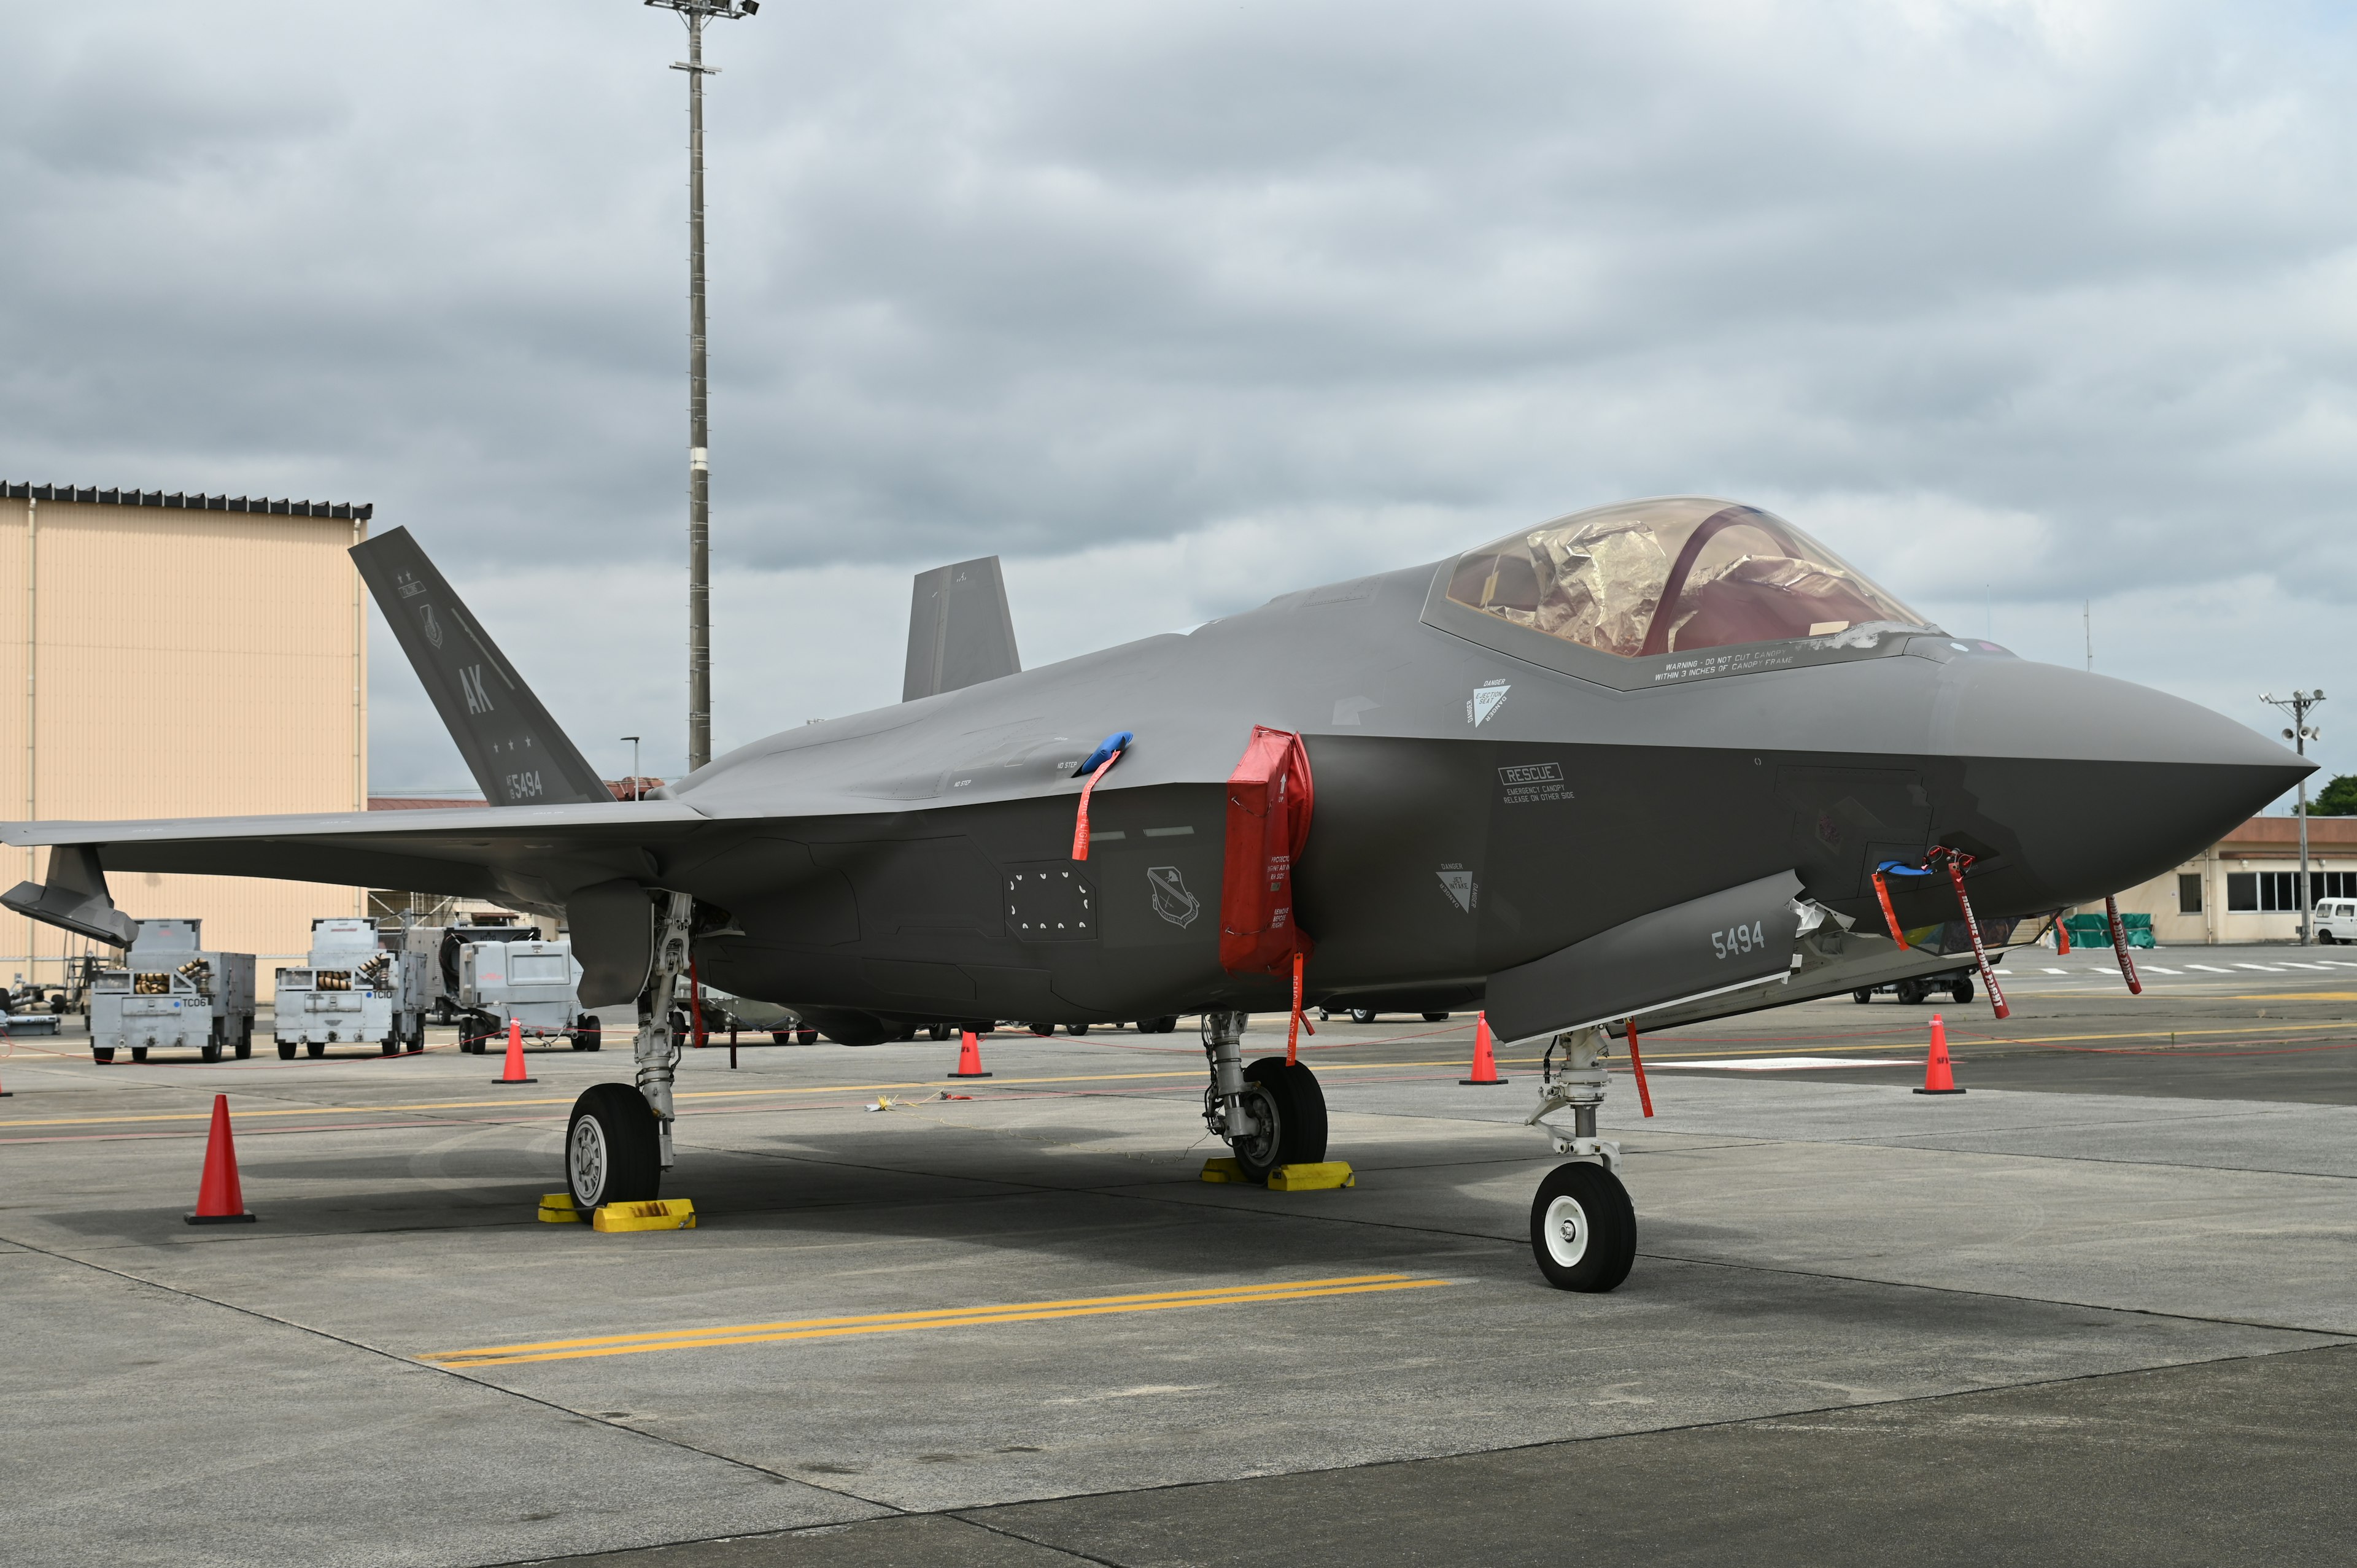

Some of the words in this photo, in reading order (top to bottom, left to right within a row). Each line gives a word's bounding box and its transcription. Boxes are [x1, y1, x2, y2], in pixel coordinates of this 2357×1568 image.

[1655, 671, 1679, 681] WITHIN
[1689, 666, 1716, 676] INCHES
[1732, 660, 1763, 670] CANOPY
[1765, 656, 1794, 666] FRAME
[1666, 660, 1698, 671] WARNING
[1717, 655, 1732, 664] NOT
[1735, 653, 1751, 662] CUT
[1754, 649, 1786, 659] CANOPY
[459, 664, 495, 715] AK
[1483, 678, 1506, 687] DANGER
[1485, 696, 1507, 722] DANGER
[511, 770, 543, 799] 5494
[1506, 765, 1555, 782] RESCUE
[1503, 795, 1530, 805] RELEASE
[1540, 792, 1560, 801] OTHER
[1561, 791, 1575, 800] SIDE
[1506, 786, 1540, 796] EMERGENCY
[1542, 784, 1565, 793] CANOPY
[1078, 819, 1089, 850] FLIGHT
[1439, 882, 1460, 908] DANGER
[1711, 921, 1765, 960] 5494
[1962, 895, 1979, 936] REMOVE
[1973, 937, 1991, 974] BEFORE
[1984, 975, 2004, 1007] FLIGHT
[2113, 922, 2127, 956] BEFORE
[182, 998, 206, 1007] TC06
[373, 990, 392, 999] TC10
